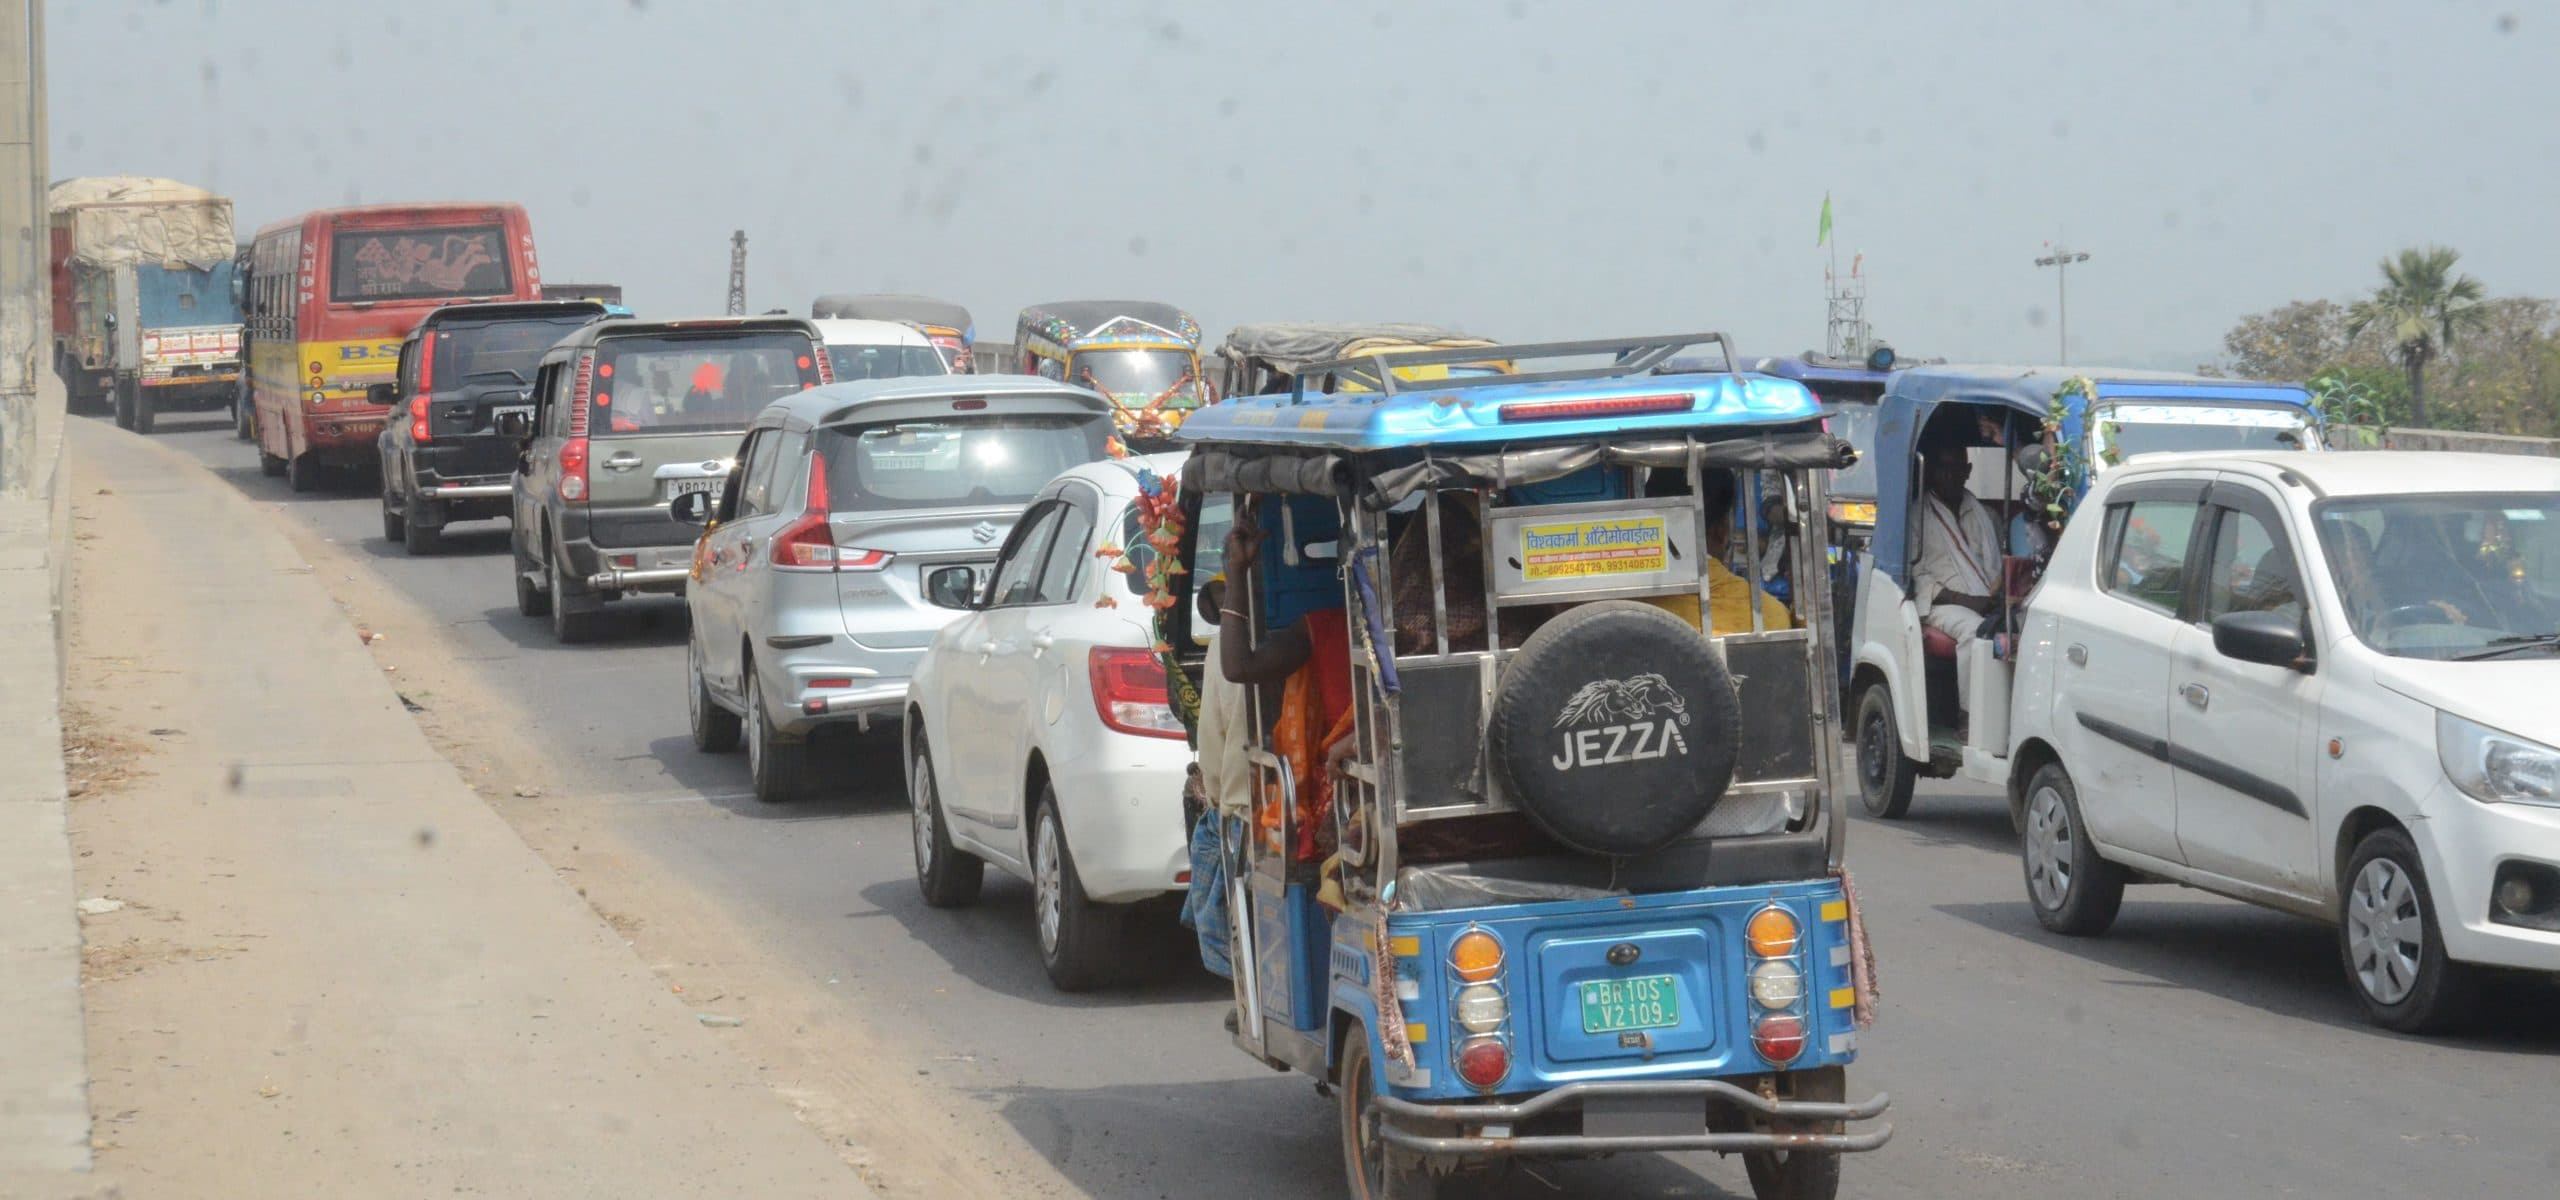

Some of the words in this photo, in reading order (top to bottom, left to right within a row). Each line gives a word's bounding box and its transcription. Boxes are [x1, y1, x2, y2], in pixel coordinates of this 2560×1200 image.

[301, 242, 314, 304] STOP
[522, 233, 540, 296] STOP
[344, 423, 376, 433] STOP
[1552, 719, 1687, 770] JEZZA
[1600, 979, 1660, 1005] BR10S
[1602, 1001, 1662, 1028] V2109
